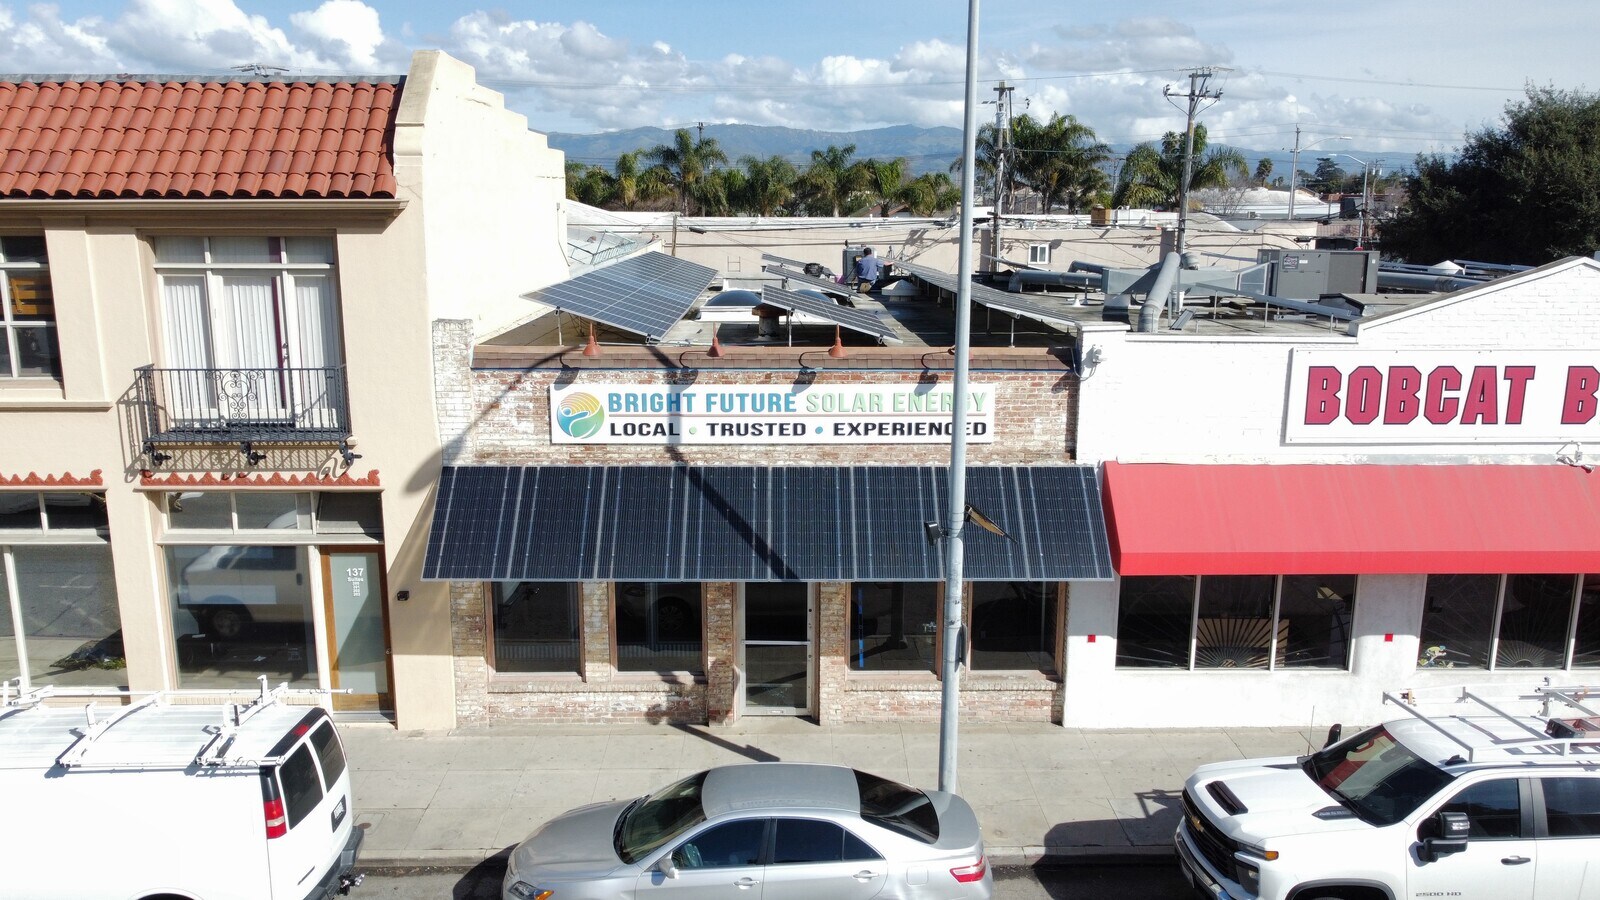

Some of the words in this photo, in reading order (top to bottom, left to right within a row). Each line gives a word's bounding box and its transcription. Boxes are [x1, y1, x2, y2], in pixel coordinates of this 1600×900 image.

[608, 393, 696, 413] BRIGHT
[705, 393, 797, 413] FUTURE
[806, 392, 883, 413] SOLAR
[893, 392, 986, 413] ENERY
[1304, 366, 1535, 425] BOBCAT
[609, 422, 681, 437] LOCAL
[706, 422, 806, 437] TRUSTED
[346, 567, 364, 577] 137
